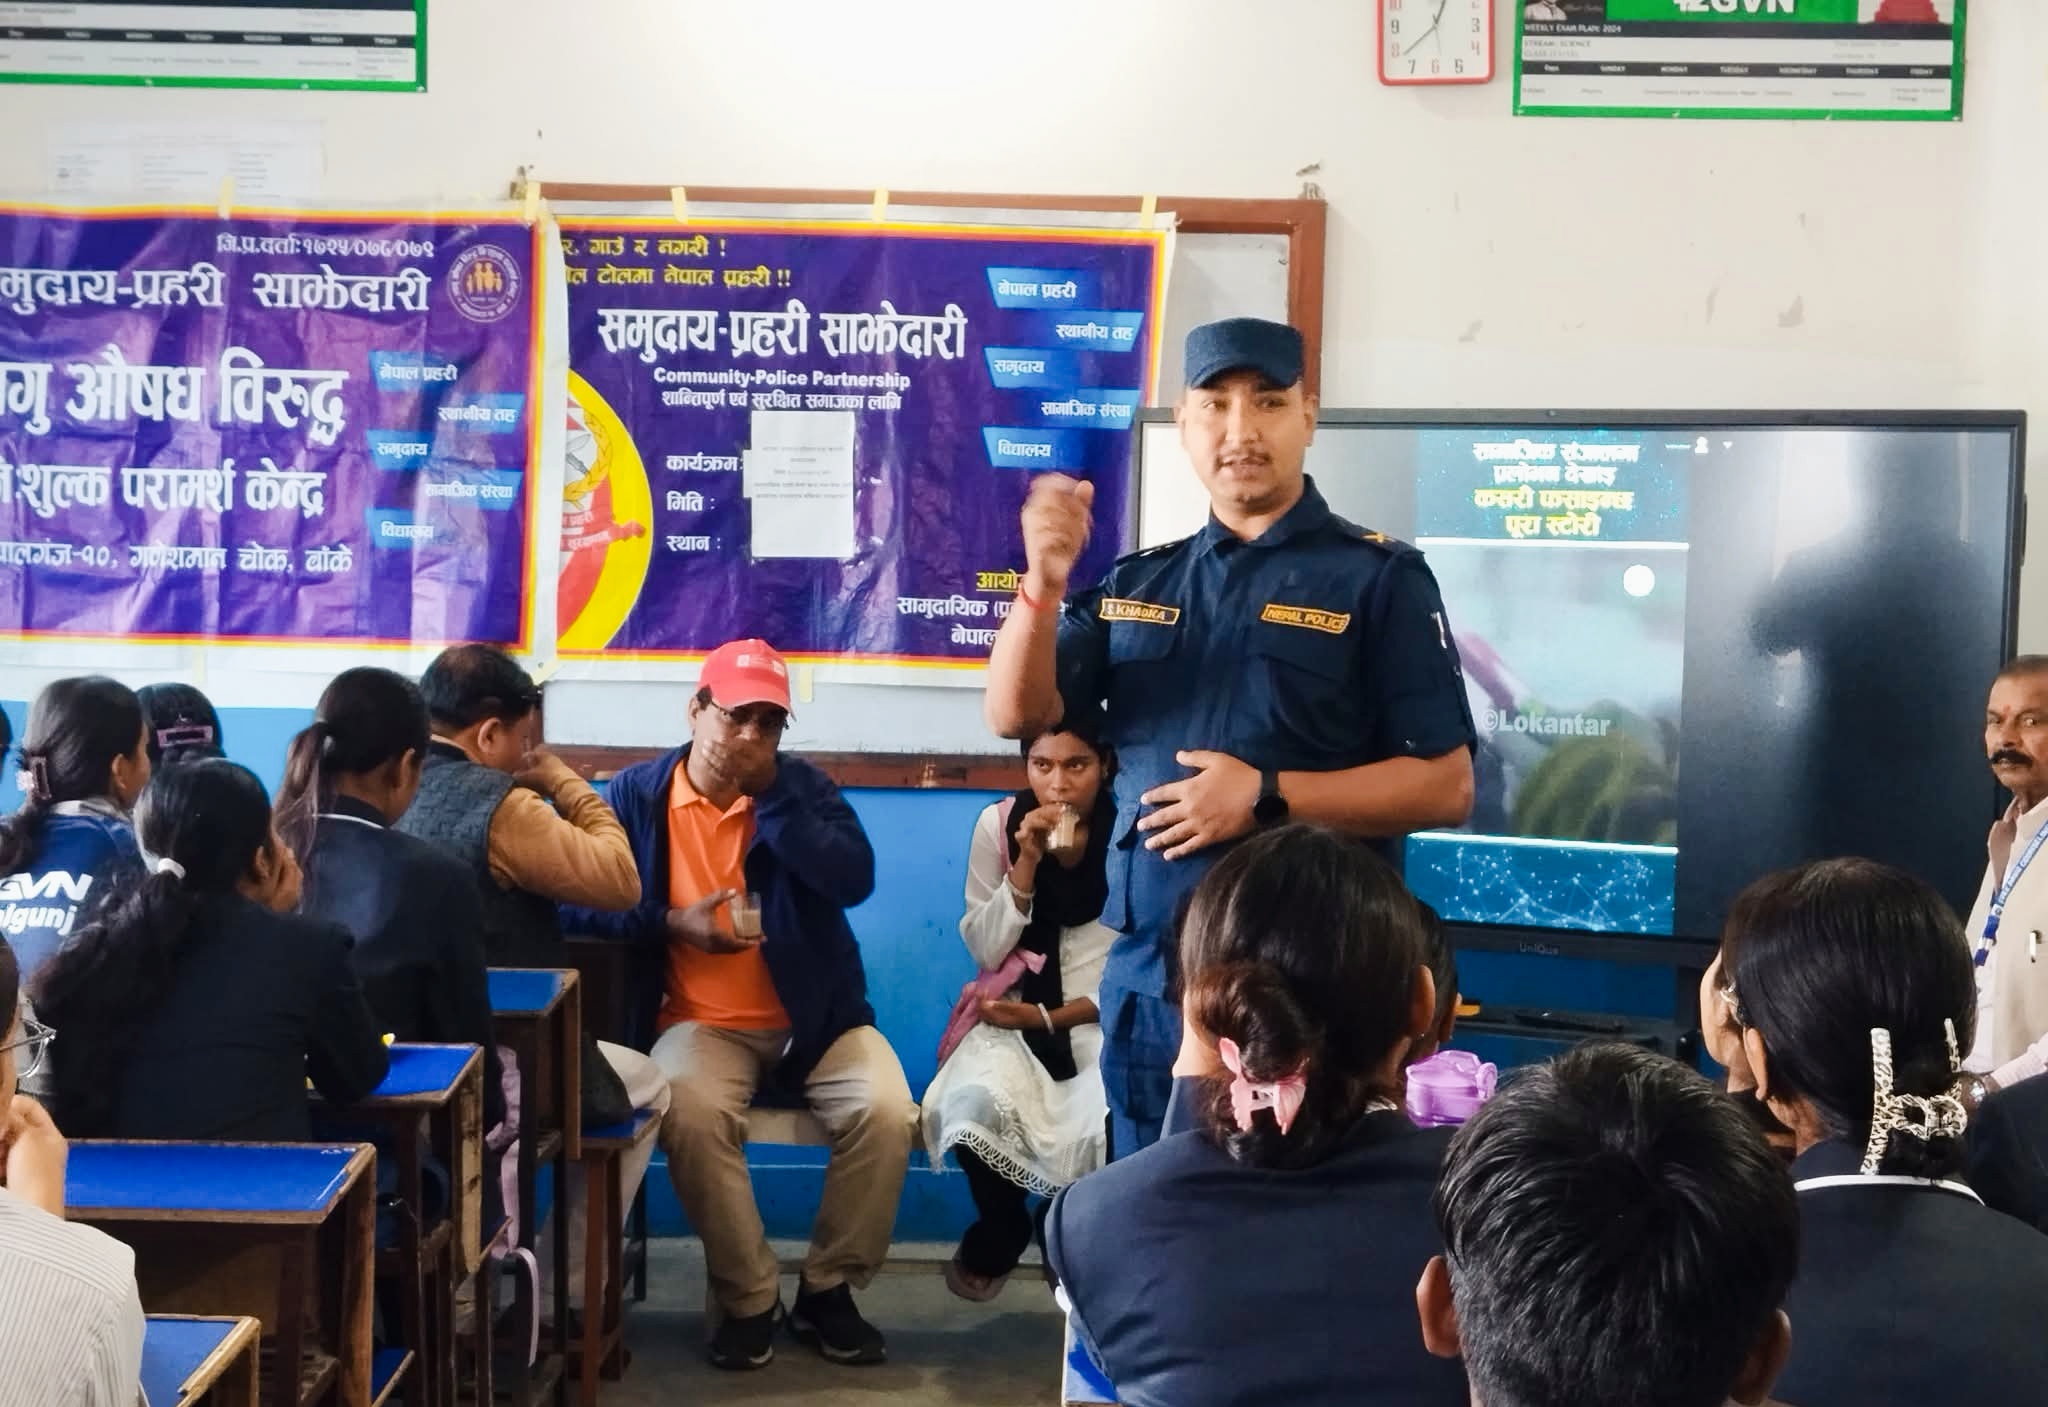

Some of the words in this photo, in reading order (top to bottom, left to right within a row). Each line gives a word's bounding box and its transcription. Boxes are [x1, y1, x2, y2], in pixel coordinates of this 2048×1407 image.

[1391, 19, 1400, 33] 9
[1472, 17, 1480, 33] 3
[1471, 40, 1480, 56] 4
[1408, 59, 1416, 74] 7
[1432, 59, 1440, 74] 6
[1455, 59, 1464, 74] 5
[633, 239, 649, 256] र
[658, 235, 709, 257] नगरी
[597, 263, 654, 284] टोलमा
[664, 263, 714, 285] नेपाल
[723, 265, 771, 289] प्रहरी
[0, 262, 226, 315] मुदाय-प्रहरी
[252, 264, 432, 312] साझेदारी
[998, 279, 1038, 296] नेपाल
[1041, 281, 1077, 299] प्रहरी
[598, 299, 811, 362] समुदाय-प्रहरी
[819, 300, 969, 359] साझेदारी
[1056, 322, 1109, 339] स्थानीय
[1112, 326, 1134, 340] तह
[380, 362, 418, 380] नेपाल
[423, 364, 458, 381] प्रहरी
[994, 359, 1045, 376] समुदाय
[65, 343, 206, 421] औषध
[653, 367, 808, 389] Community-Police
[813, 370, 911, 391] Partnership
[662, 387, 726, 411] शान्तिपूर्ण
[751, 388, 801, 411] सुरक्षित
[805, 393, 864, 410] समाजका
[867, 391, 902, 410] लागि
[1041, 399, 1096, 417] सामाजिक
[1099, 402, 1131, 418] संस्था
[438, 404, 491, 421] स्थानीय
[494, 407, 517, 422] तह
[377, 442, 429, 459] समुदाय
[998, 439, 1052, 457] विद्यालय
[122, 458, 237, 513] परामर्श
[246, 457, 328, 520] केन्द्र
[480, 483, 513, 498] संस्था
[1473, 484, 1535, 510] कसरी
[666, 489, 704, 512] मिति
[381, 521, 435, 539] विद्यालय
[1505, 514, 1541, 539] पूरा
[1545, 511, 1602, 537] स्टोरी
[0, 538, 118, 568] पालगंज-१०,
[666, 535, 710, 552] स्थान
[976, 569, 1024, 589] आयो
[897, 594, 989, 619] सामुदायिक
[1267, 609, 1303, 623] NEPAL
[1304, 613, 1345, 630] POLICE
[0, 902, 77, 936] lgunj
